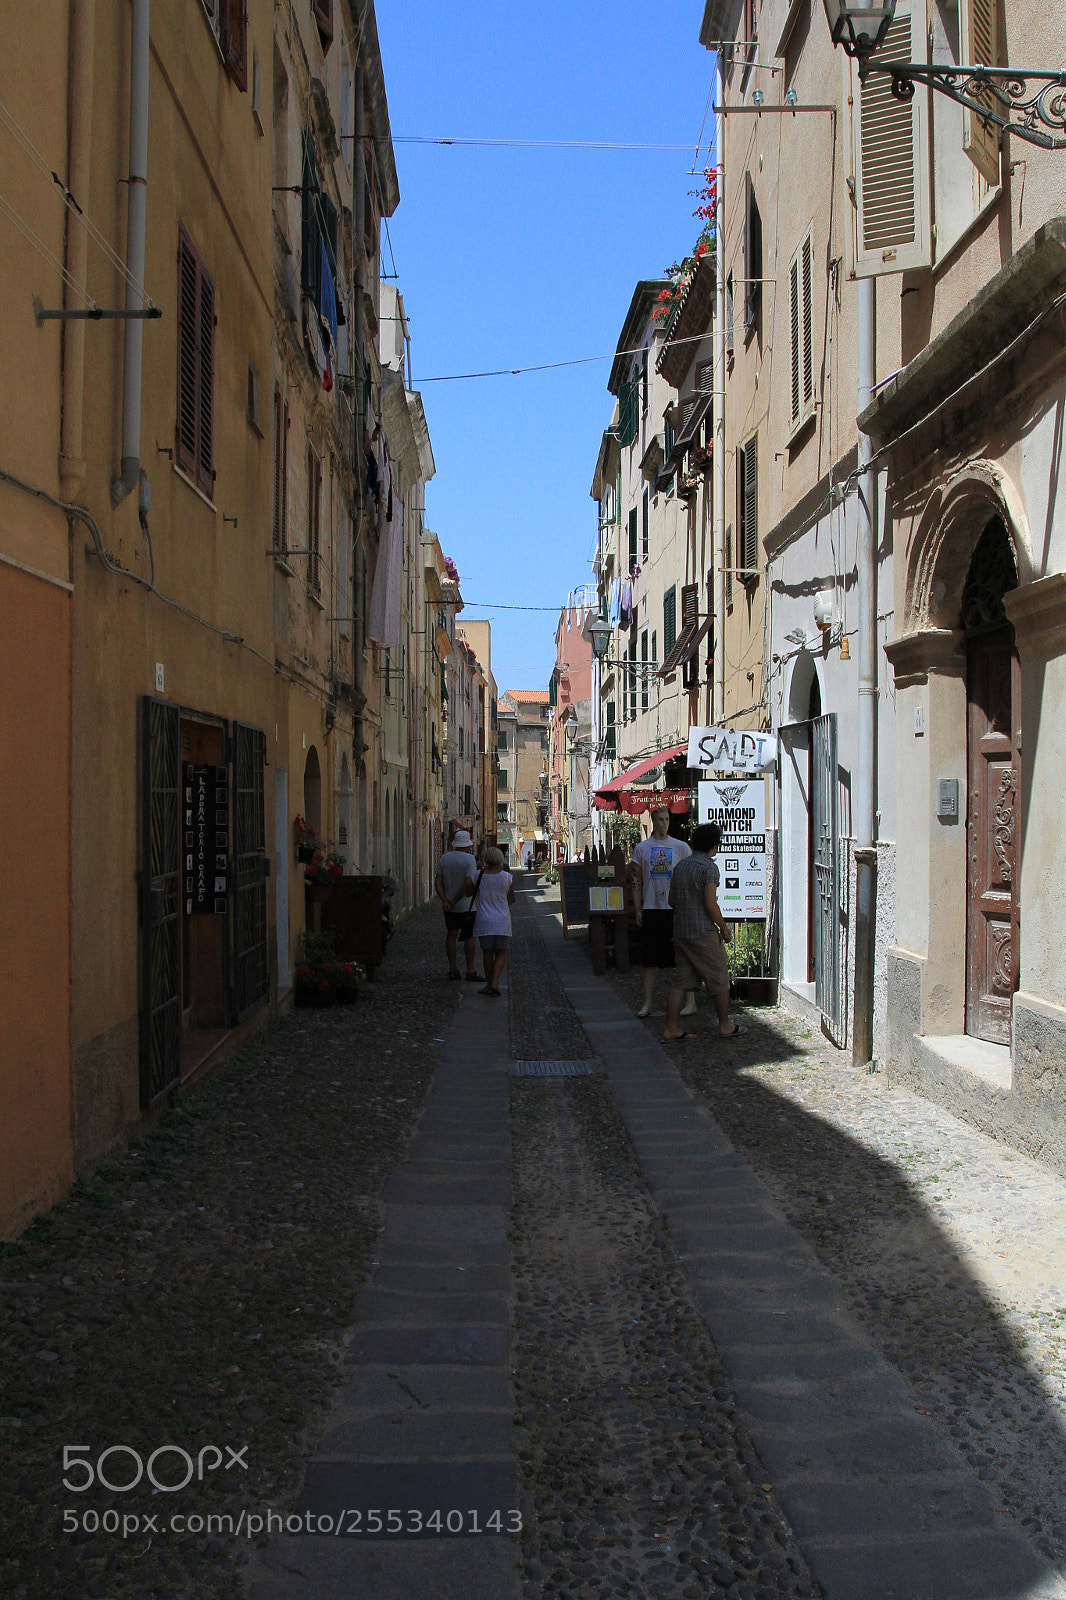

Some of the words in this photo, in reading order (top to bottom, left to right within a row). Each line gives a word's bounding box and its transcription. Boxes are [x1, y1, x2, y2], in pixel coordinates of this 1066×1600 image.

[698, 733, 767, 768] SALDI
[630, 795, 662, 805] Trattoria
[707, 807, 756, 820] DIAMOND
[719, 835, 764, 844] GLIAMENTO
[720, 844, 732, 852] And
[732, 844, 763, 853] Skateshop
